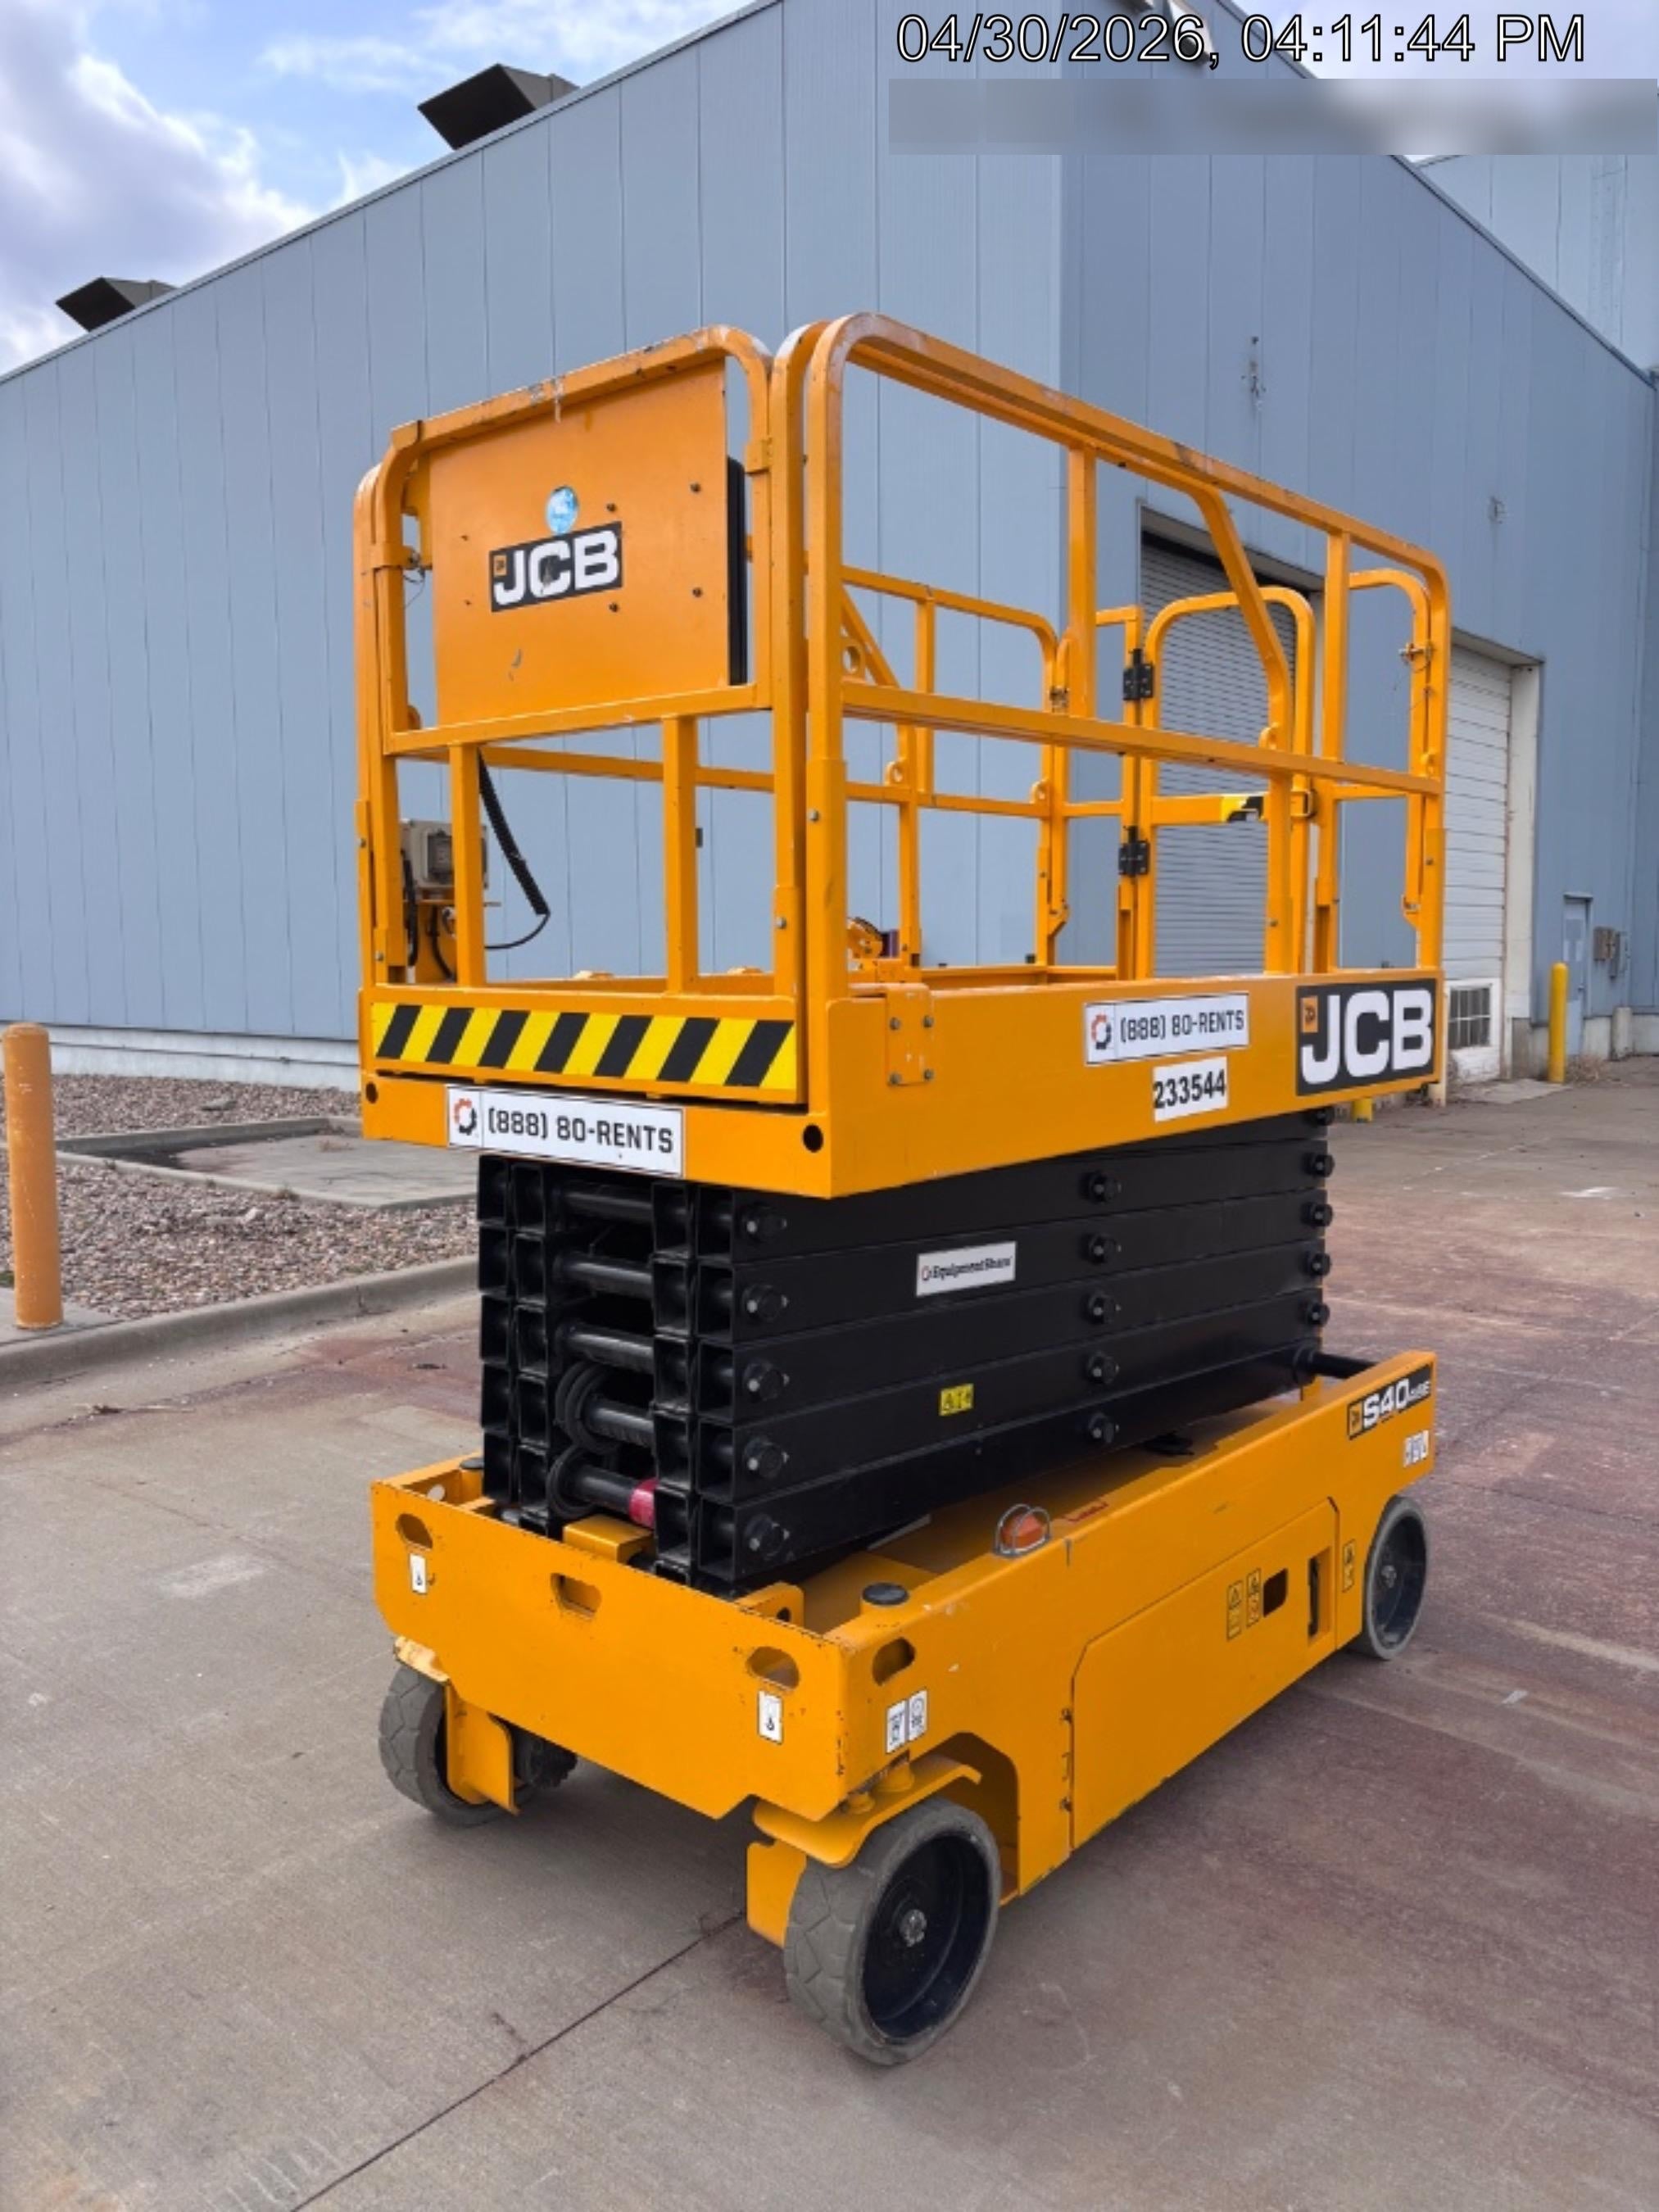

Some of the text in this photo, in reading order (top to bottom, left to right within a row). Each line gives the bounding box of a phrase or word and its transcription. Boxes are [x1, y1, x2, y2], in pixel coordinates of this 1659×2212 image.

[493, 530, 619, 605] JCB
[1120, 1009, 1244, 1044] (888) 80-RENTS
[1300, 988, 1434, 1085] JCB
[1154, 1068, 1226, 1109] 233544
[488, 1107, 673, 1154] (888) 80-RENTS
